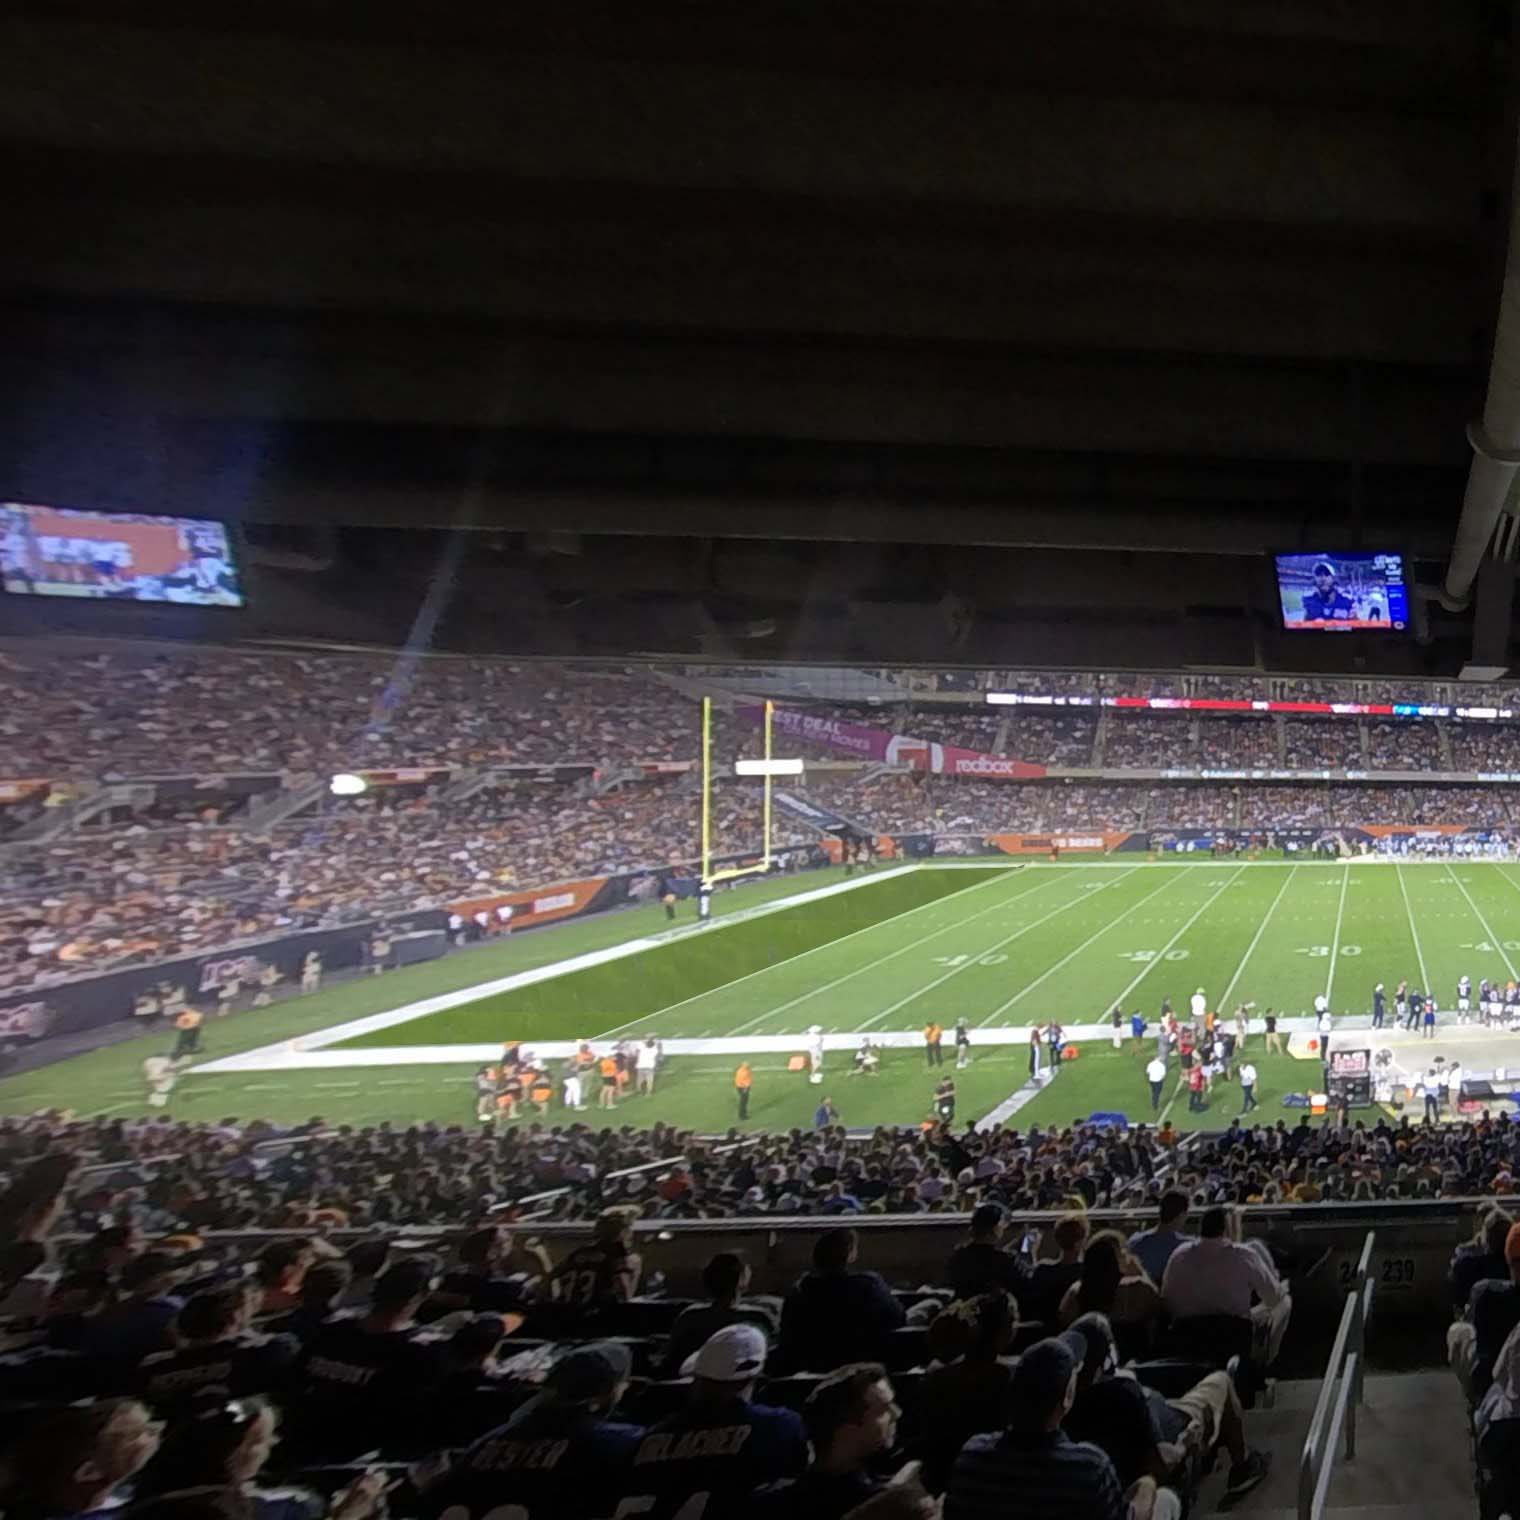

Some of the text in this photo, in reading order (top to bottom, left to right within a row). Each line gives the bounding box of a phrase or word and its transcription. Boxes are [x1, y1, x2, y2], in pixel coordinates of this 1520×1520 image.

[803, 716, 841, 735] DEAL
[956, 758, 1013, 775] redbox
[1382, 1258, 1414, 1281] 239
